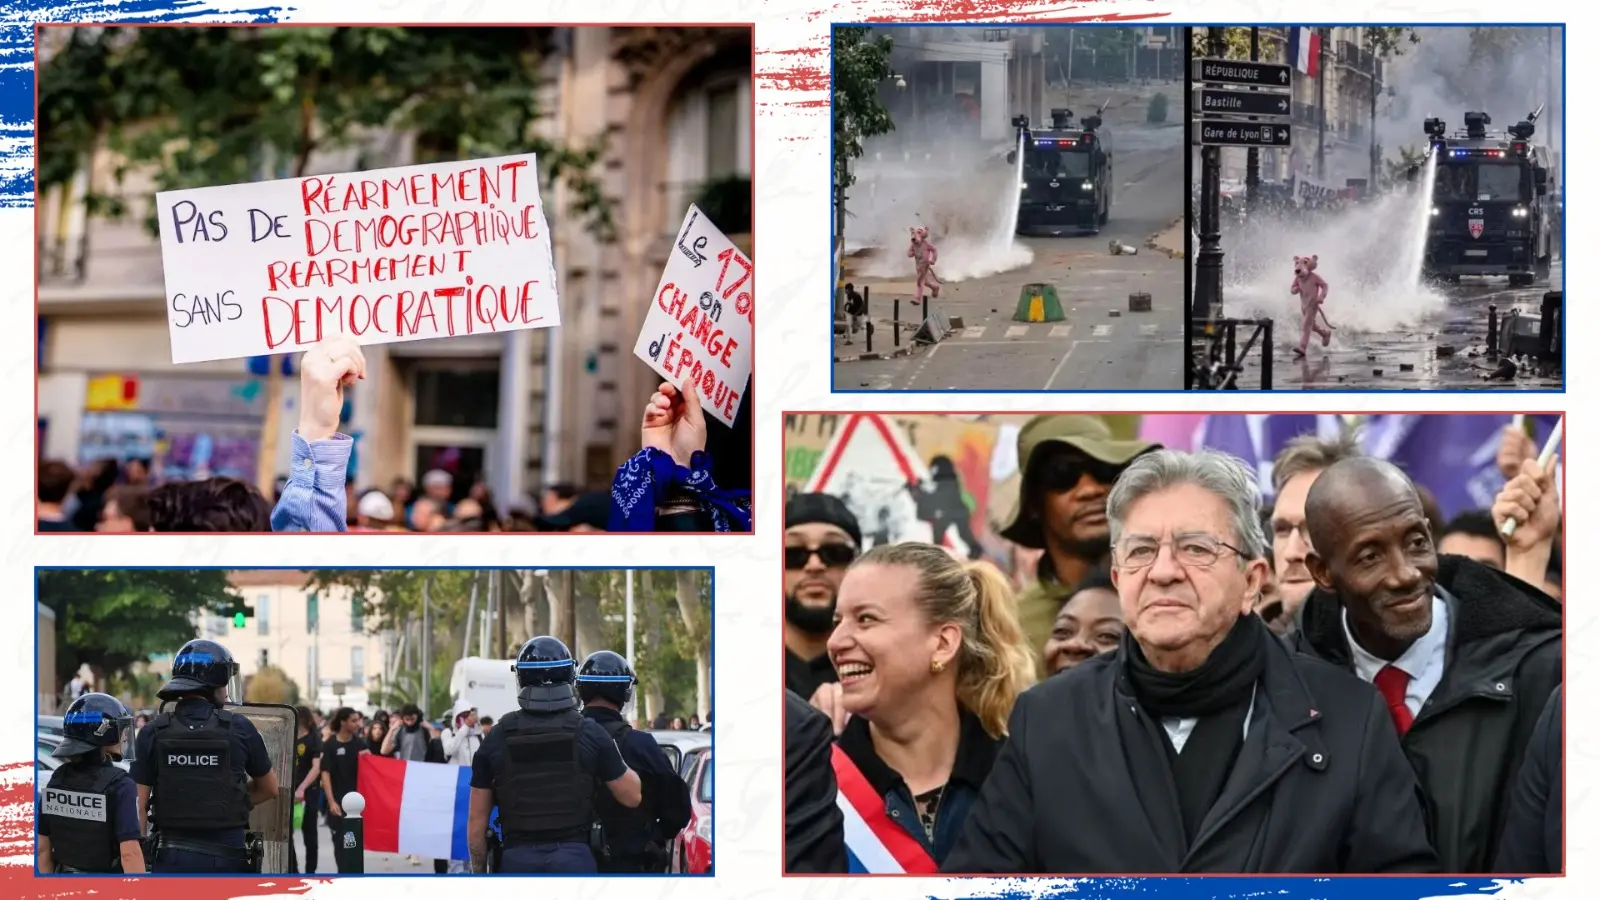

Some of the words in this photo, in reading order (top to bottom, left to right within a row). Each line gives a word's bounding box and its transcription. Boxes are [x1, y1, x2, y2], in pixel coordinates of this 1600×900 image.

[1205, 65, 1259, 79] RÉPUBLIQUE
[1205, 96, 1242, 108] Bastille
[1204, 127, 1224, 137] Gare
[1227, 128, 1238, 138] de
[1240, 129, 1260, 141] Lyon
[172, 200, 228, 243] PAS
[248, 209, 292, 243] DE
[302, 160, 528, 216] RÉARMEMENT
[678, 211, 707, 268] Le
[173, 290, 243, 328] SANS
[699, 291, 722, 323] on
[658, 282, 739, 369] CHANGE
[168, 754, 219, 766] POLICE
[46, 791, 103, 809] POLICE
[46, 804, 102, 818] NATIONALE
